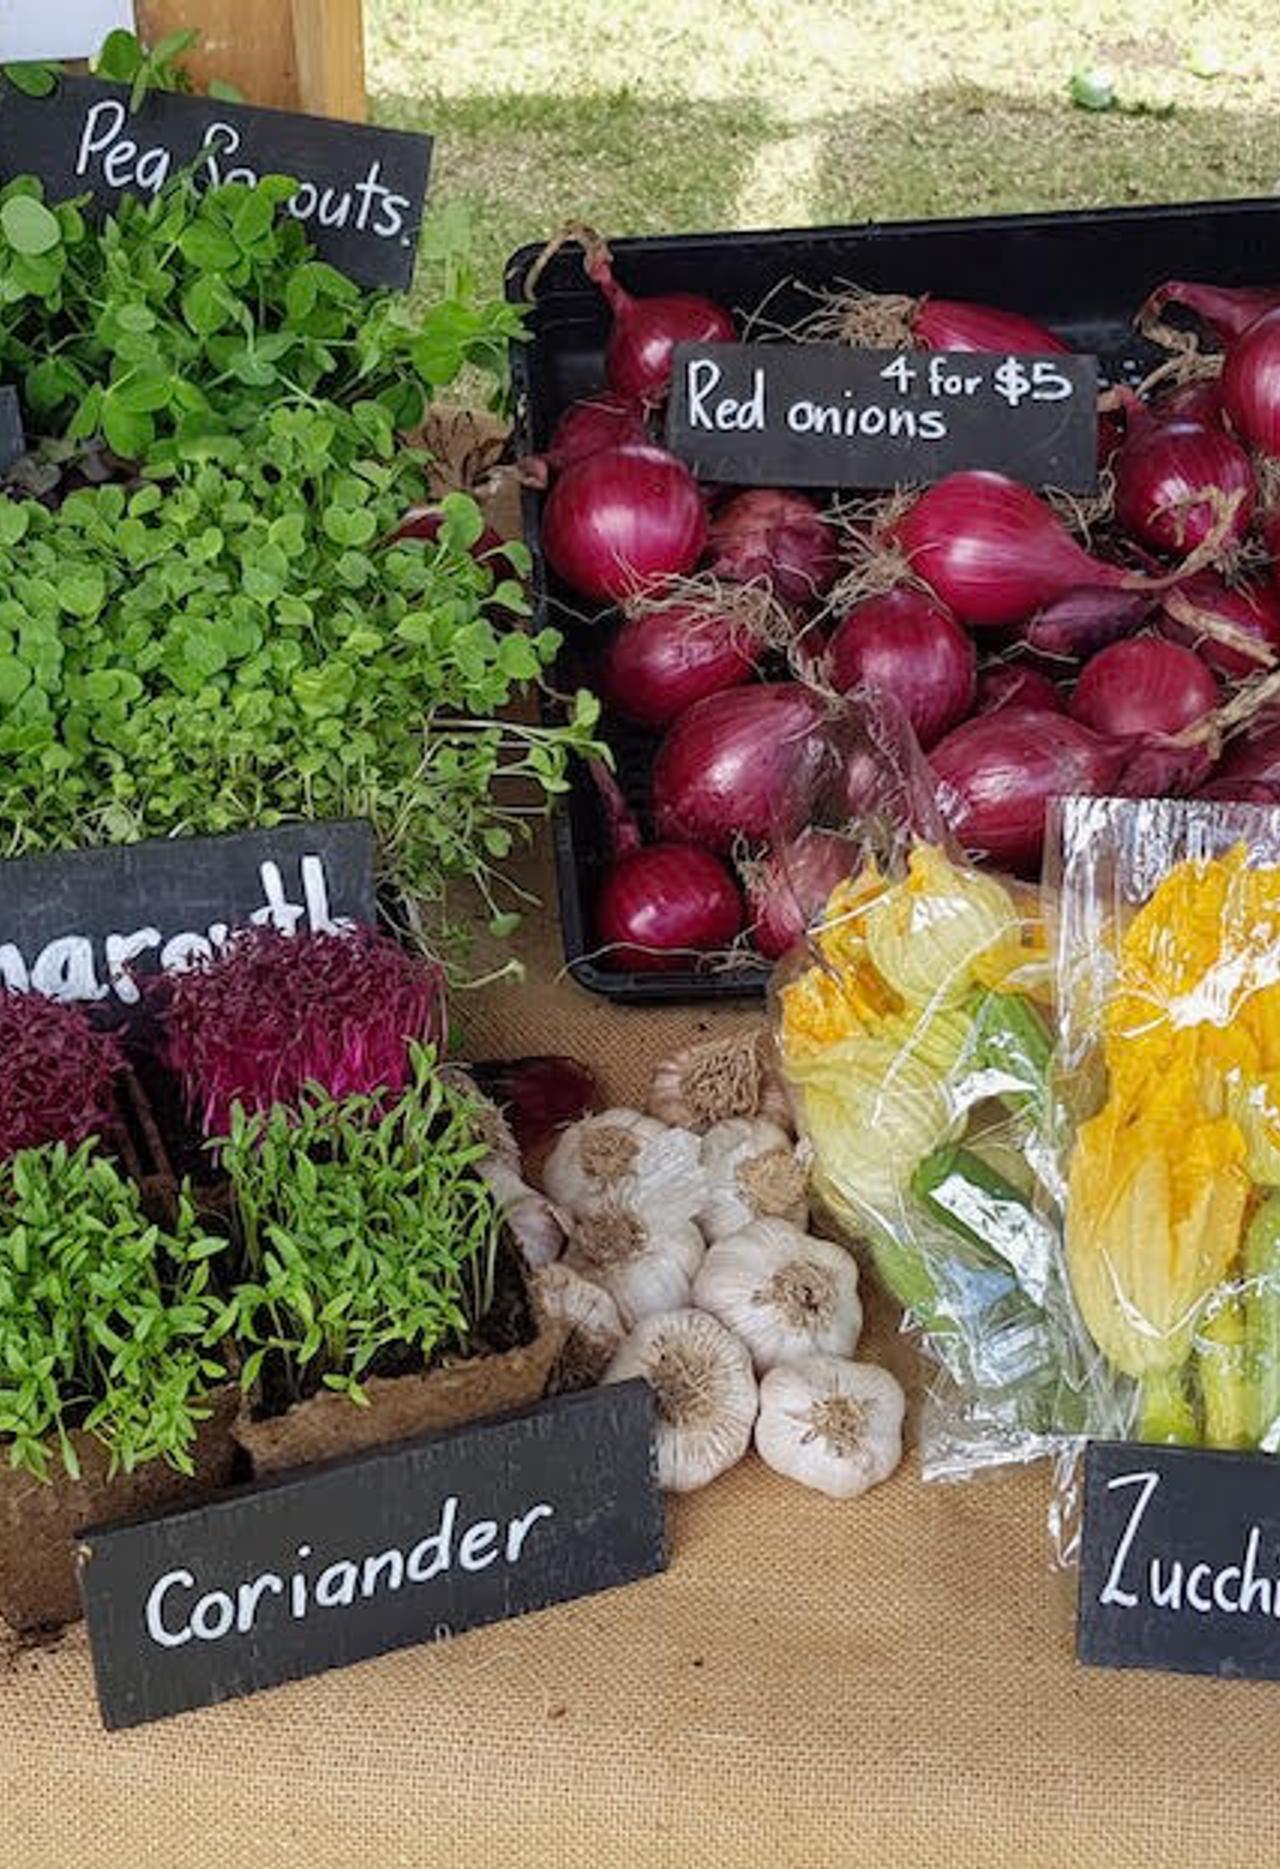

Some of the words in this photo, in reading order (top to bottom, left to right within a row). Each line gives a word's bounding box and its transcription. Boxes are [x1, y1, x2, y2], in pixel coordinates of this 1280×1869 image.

[75, 99, 171, 193] Pea
[688, 358, 766, 431] Red
[786, 389, 948, 439] onions
[879, 355, 916, 393] 4
[927, 356, 983, 396] for
[994, 356, 1074, 407] $5
[145, 1496, 554, 1648] Coriander
